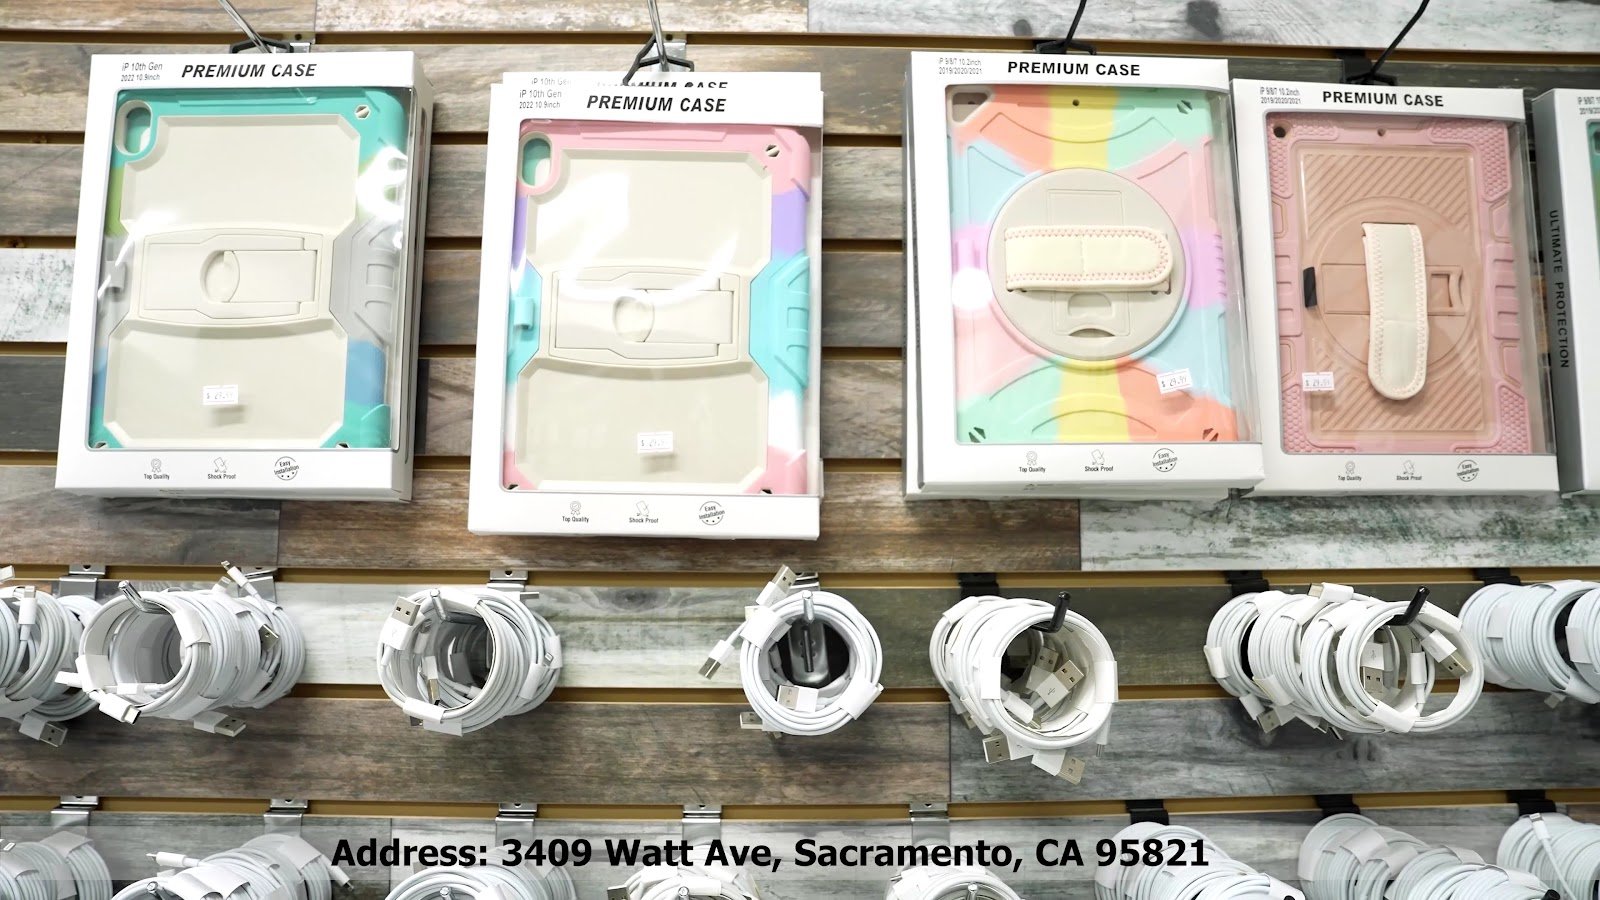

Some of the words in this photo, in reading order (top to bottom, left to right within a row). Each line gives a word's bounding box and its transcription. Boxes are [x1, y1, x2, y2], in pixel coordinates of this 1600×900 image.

[131, 62, 146, 71] 10th
[148, 61, 163, 71] Gen
[181, 64, 266, 78] PREMIUM
[271, 63, 318, 77] CASE
[1008, 61, 1089, 75] PREMIUM
[1096, 63, 1141, 76] CASE
[121, 74, 134, 82] 2022
[519, 89, 527, 98] iP
[529, 89, 545, 98] 10th
[546, 89, 562, 98] Gen
[1323, 91, 1397, 105] PREMIUM
[1403, 93, 1444, 107] CASE
[519, 101, 533, 109] 2022
[587, 95, 673, 111] PREMIUM
[680, 97, 727, 112] CASE
[1549, 209, 1563, 273] ULTIMATE
[1554, 281, 1569, 368] PROTECTION
[1152, 456, 1178, 467] Installation
[1158, 452, 1169, 460] Easy
[274, 464, 299, 475] Installation
[279, 460, 291, 468] Easy
[699, 509, 725, 520] Installation
